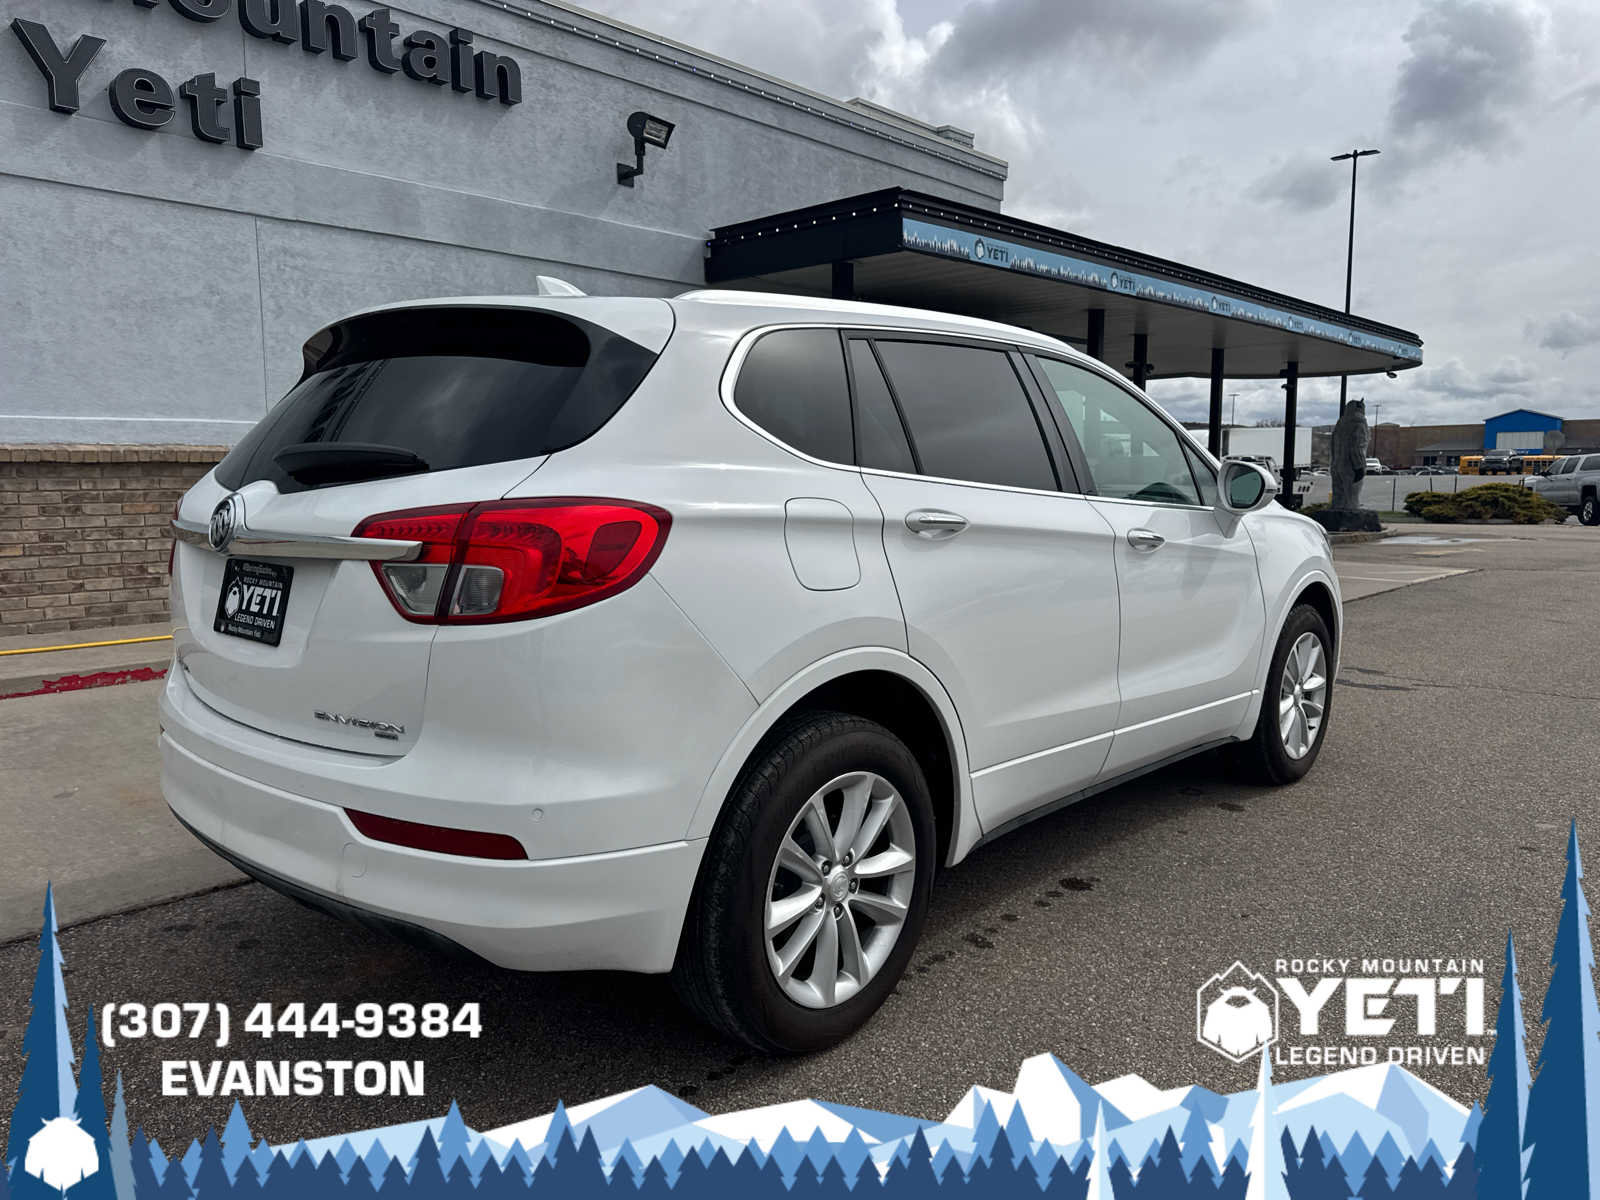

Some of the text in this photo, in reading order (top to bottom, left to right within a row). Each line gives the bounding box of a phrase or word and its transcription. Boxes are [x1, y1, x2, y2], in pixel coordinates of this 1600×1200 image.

[11, 17, 263, 149] Yeti
[986, 246, 1009, 263] YETI
[1119, 279, 1136, 291] YETI
[241, 584, 281, 616] YETI
[234, 613, 276, 629] LEGEND DRIVEN
[314, 711, 405, 734] ENVISION
